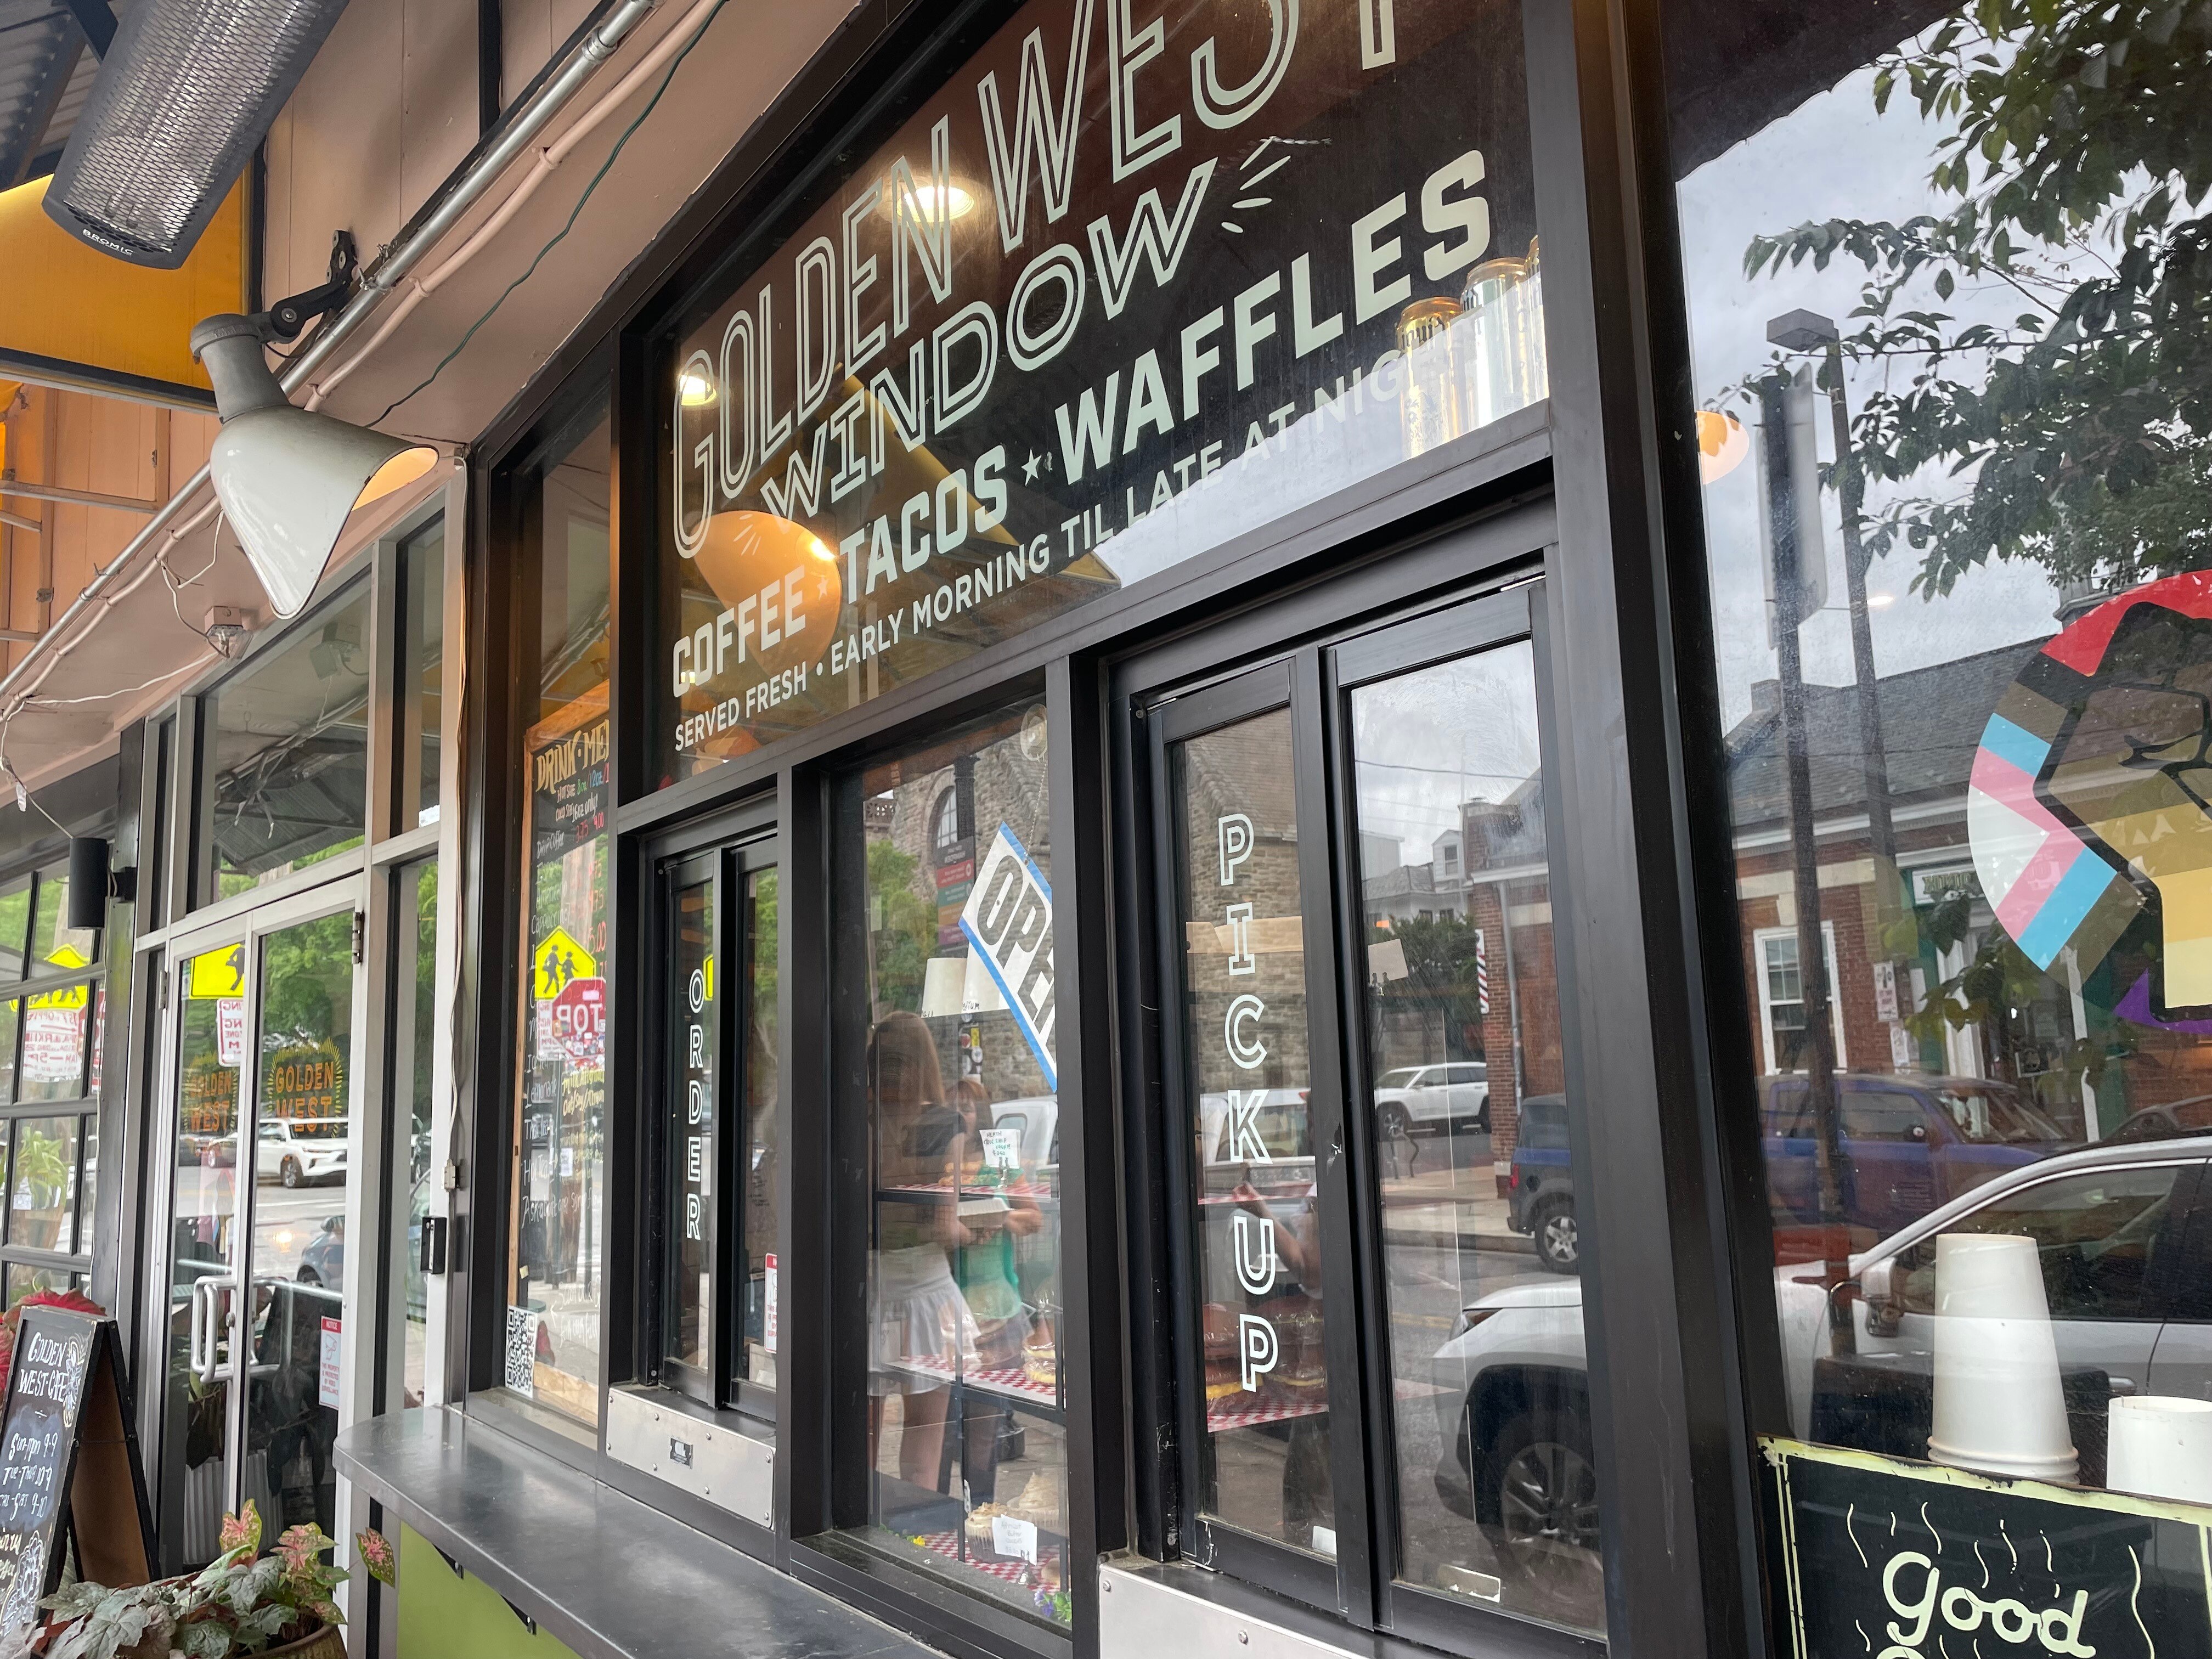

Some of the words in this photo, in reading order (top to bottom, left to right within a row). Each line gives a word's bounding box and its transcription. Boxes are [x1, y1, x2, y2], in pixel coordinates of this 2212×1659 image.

[83, 229, 133, 253] BROMIC
[673, 114, 952, 558] GOLDEN
[977, 0, 1396, 254] WES
[760, 157, 1218, 533] WINDOW
[673, 565, 806, 697] COFFEE
[839, 444, 1007, 604] TACOS
[1054, 150, 1491, 485] WAFFLES
[675, 700, 739, 752] SERVED
[746, 661, 806, 719] FRESH
[832, 608, 904, 675] EARLY
[913, 533, 1049, 635] MORNING
[1060, 503, 1115, 558] TIL
[1127, 440, 1223, 525] LATE
[1242, 402, 1295, 470] AT
[536, 730, 582, 794] DRINK
[977, 855, 1056, 1064] OPE
[190, 1100, 230, 1132] WEST
[275, 1061, 334, 1093] GOLDEN
[276, 1096, 332, 1132] WEST
[686, 968, 704, 1241] ORDER
[28, 1332, 67, 1367] GOLDEN
[1883, 1551, 2096, 1658] good
